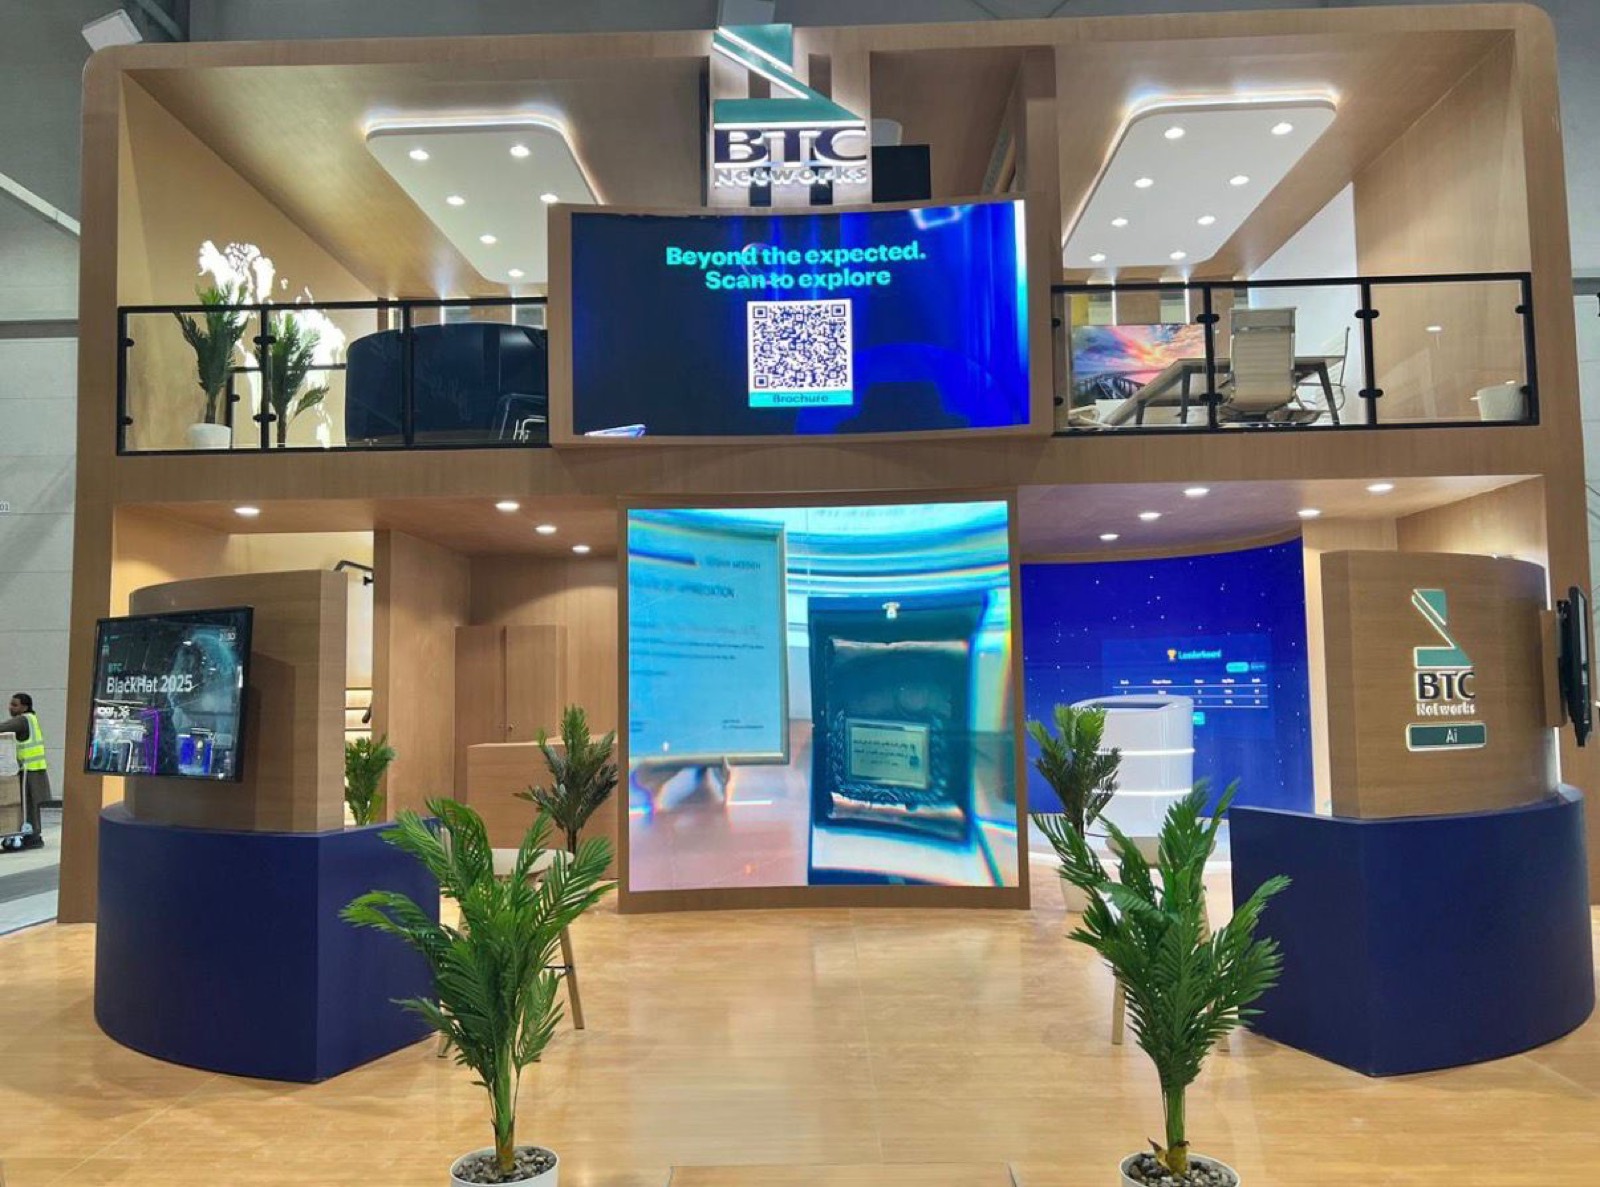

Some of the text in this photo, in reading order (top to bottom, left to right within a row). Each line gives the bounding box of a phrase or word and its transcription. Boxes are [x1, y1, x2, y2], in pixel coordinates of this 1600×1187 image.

[714, 128, 867, 164] BTC
[714, 167, 867, 186] Networks
[665, 240, 927, 269] Beyond the expected.
[705, 268, 892, 290] Scan to explore
[773, 393, 829, 403] Brochure
[106, 674, 193, 693] BlackHat 2025
[1415, 670, 1476, 701] BTC
[1445, 728, 1458, 744] Ai
